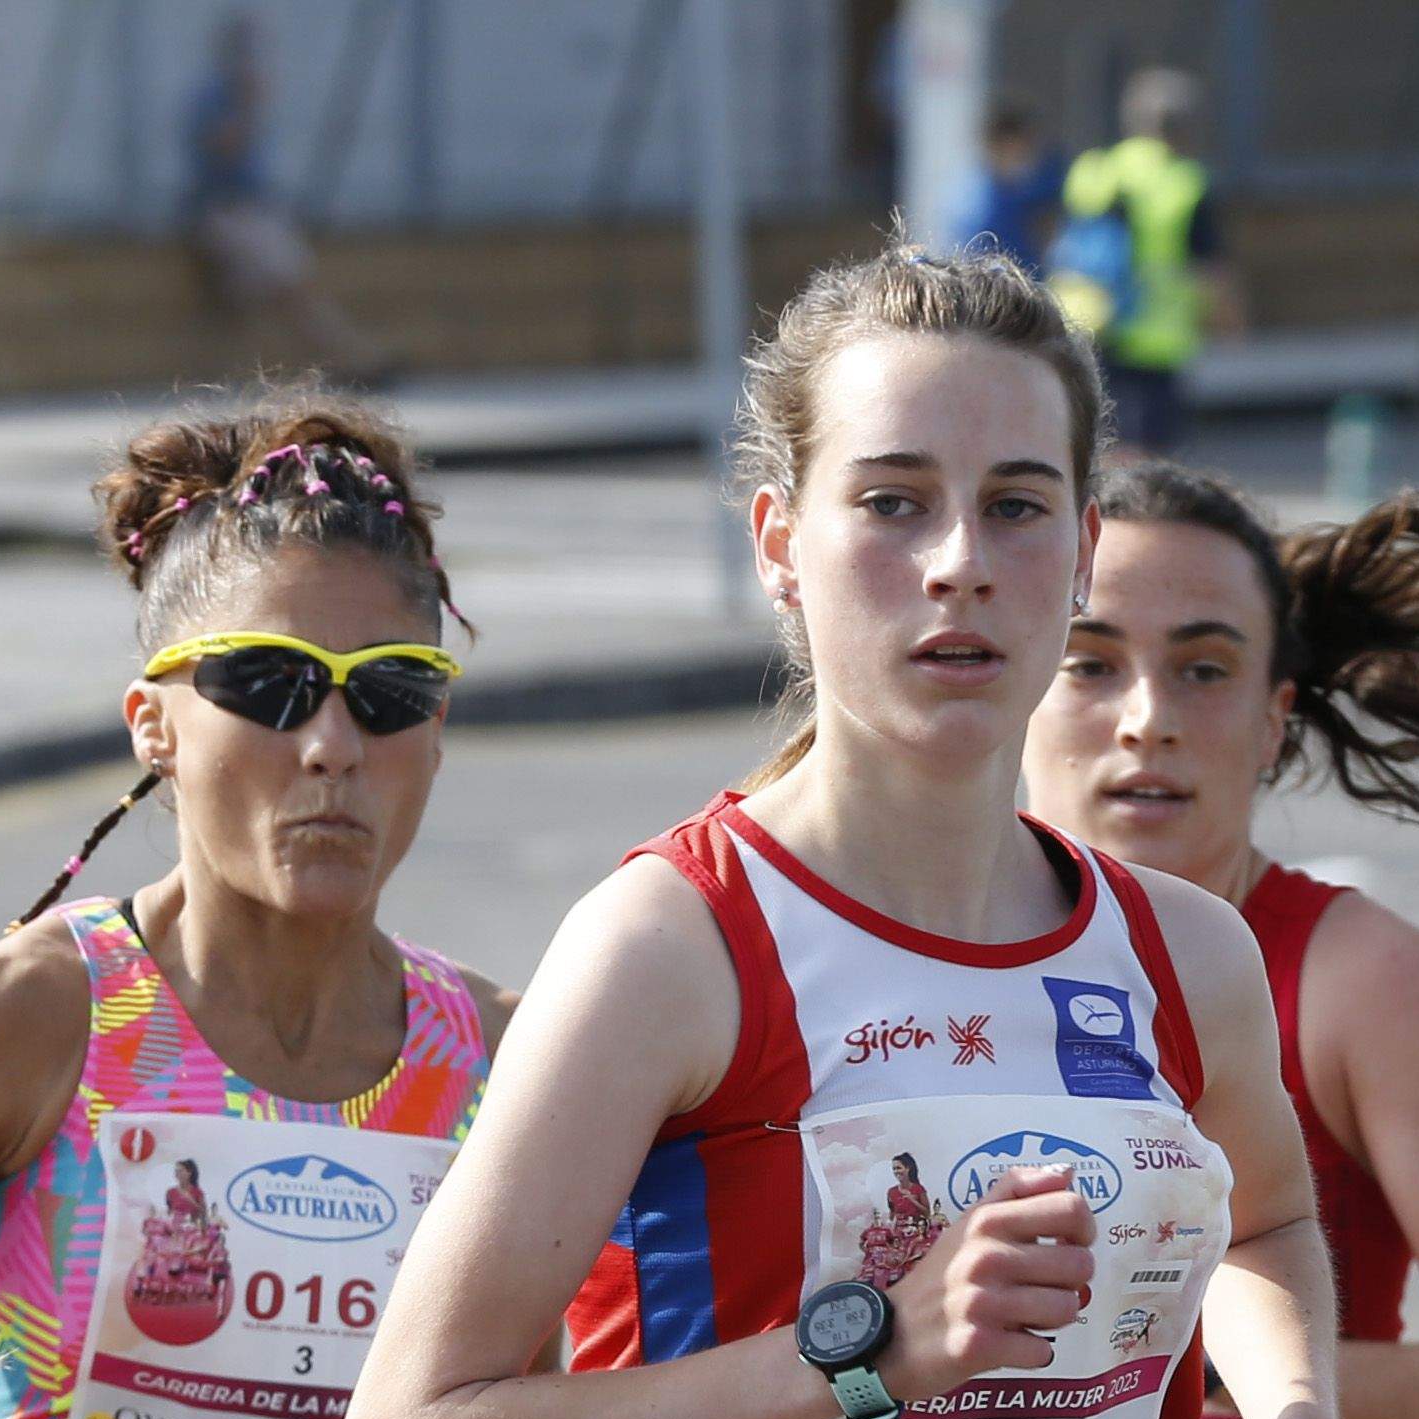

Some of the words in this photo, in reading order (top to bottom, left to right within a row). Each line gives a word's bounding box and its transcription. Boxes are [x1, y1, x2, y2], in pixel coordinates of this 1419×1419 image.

[844, 1014, 936, 1064] gijón
[1125, 1138, 1142, 1149] TU
[1146, 1138, 1186, 1151] DORS
[241, 1182, 384, 1224] ASTURIANA
[1109, 1223, 1147, 1245] gijón
[245, 1270, 377, 1328] 016
[293, 1345, 313, 1375] 3
[133, 1370, 245, 1406] CARRERA
[251, 1390, 284, 1410] DE
[288, 1394, 320, 1415] LA
[960, 1391, 988, 1411] DE
[995, 1391, 1026, 1408] LA
[1032, 1384, 1105, 1409] MUJER
[1107, 1369, 1142, 1398] 2023
